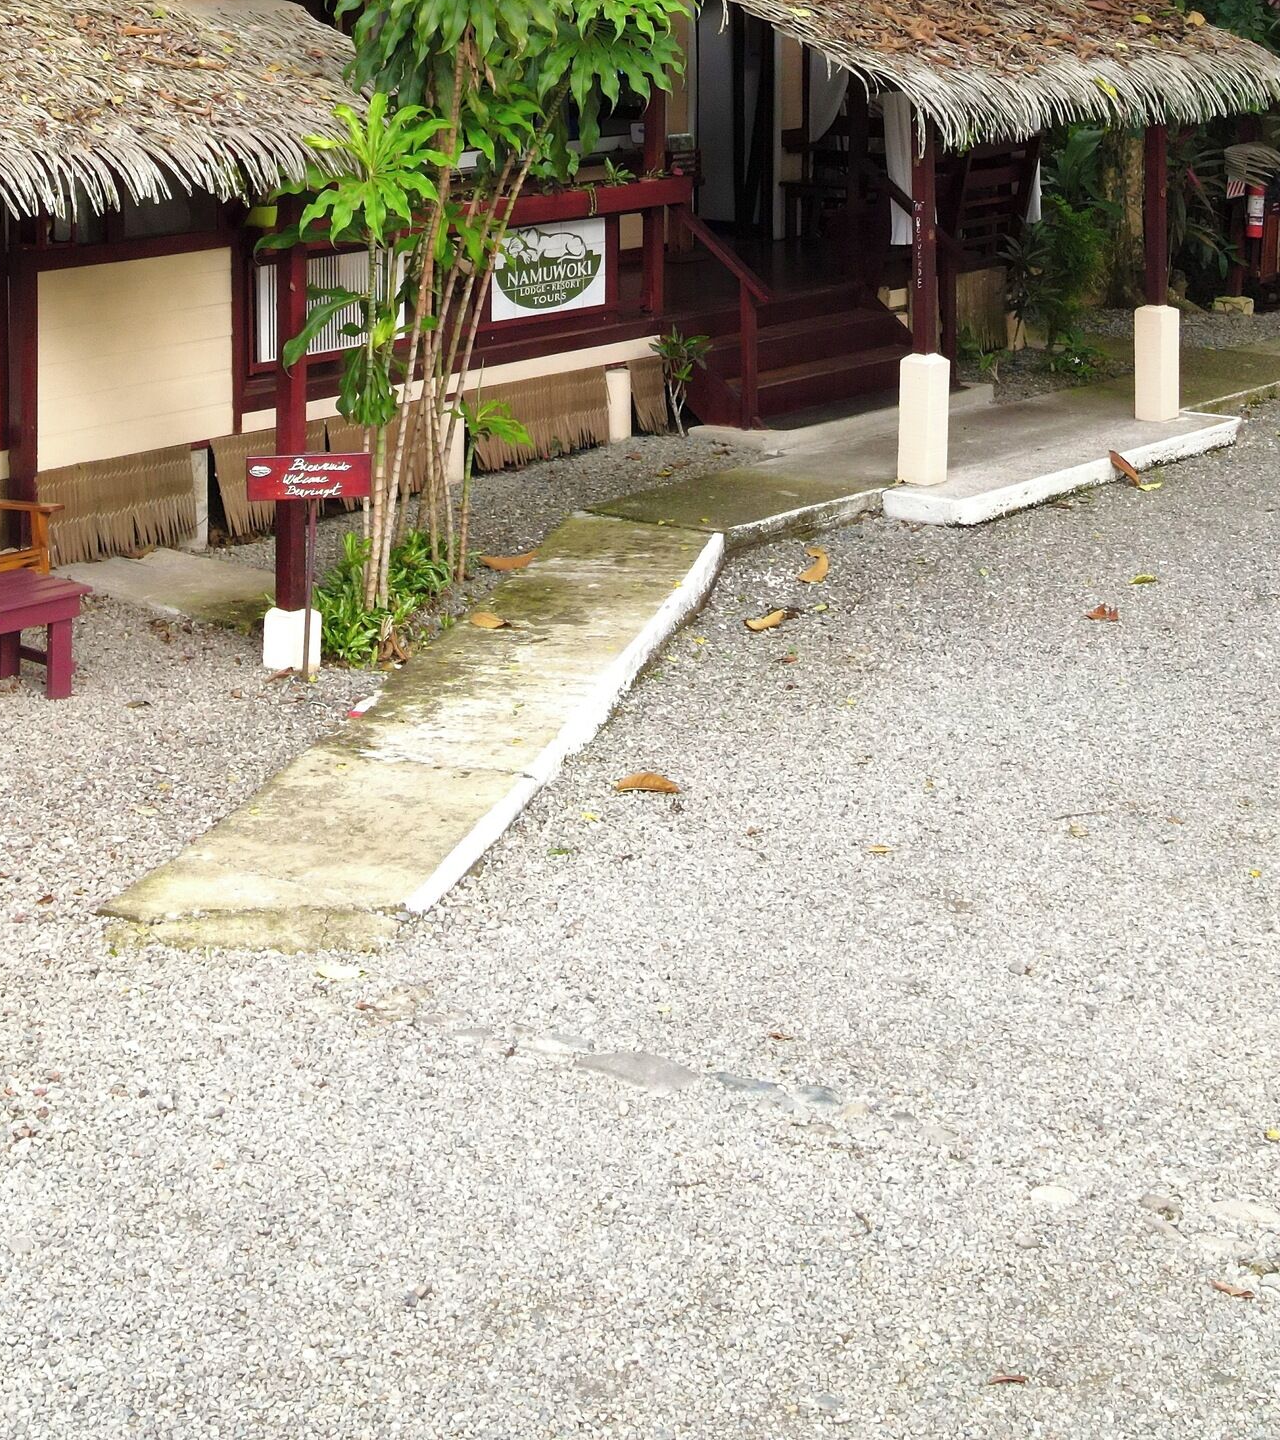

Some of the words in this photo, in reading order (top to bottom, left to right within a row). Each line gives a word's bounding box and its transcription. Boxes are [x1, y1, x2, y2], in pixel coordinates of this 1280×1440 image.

[507, 260, 592, 287] NAMUWOKI
[519, 286, 546, 297] LODGE
[552, 280, 580, 291] RESORT
[533, 293, 567, 305] TOURS
[282, 472, 329, 485] Welcome
